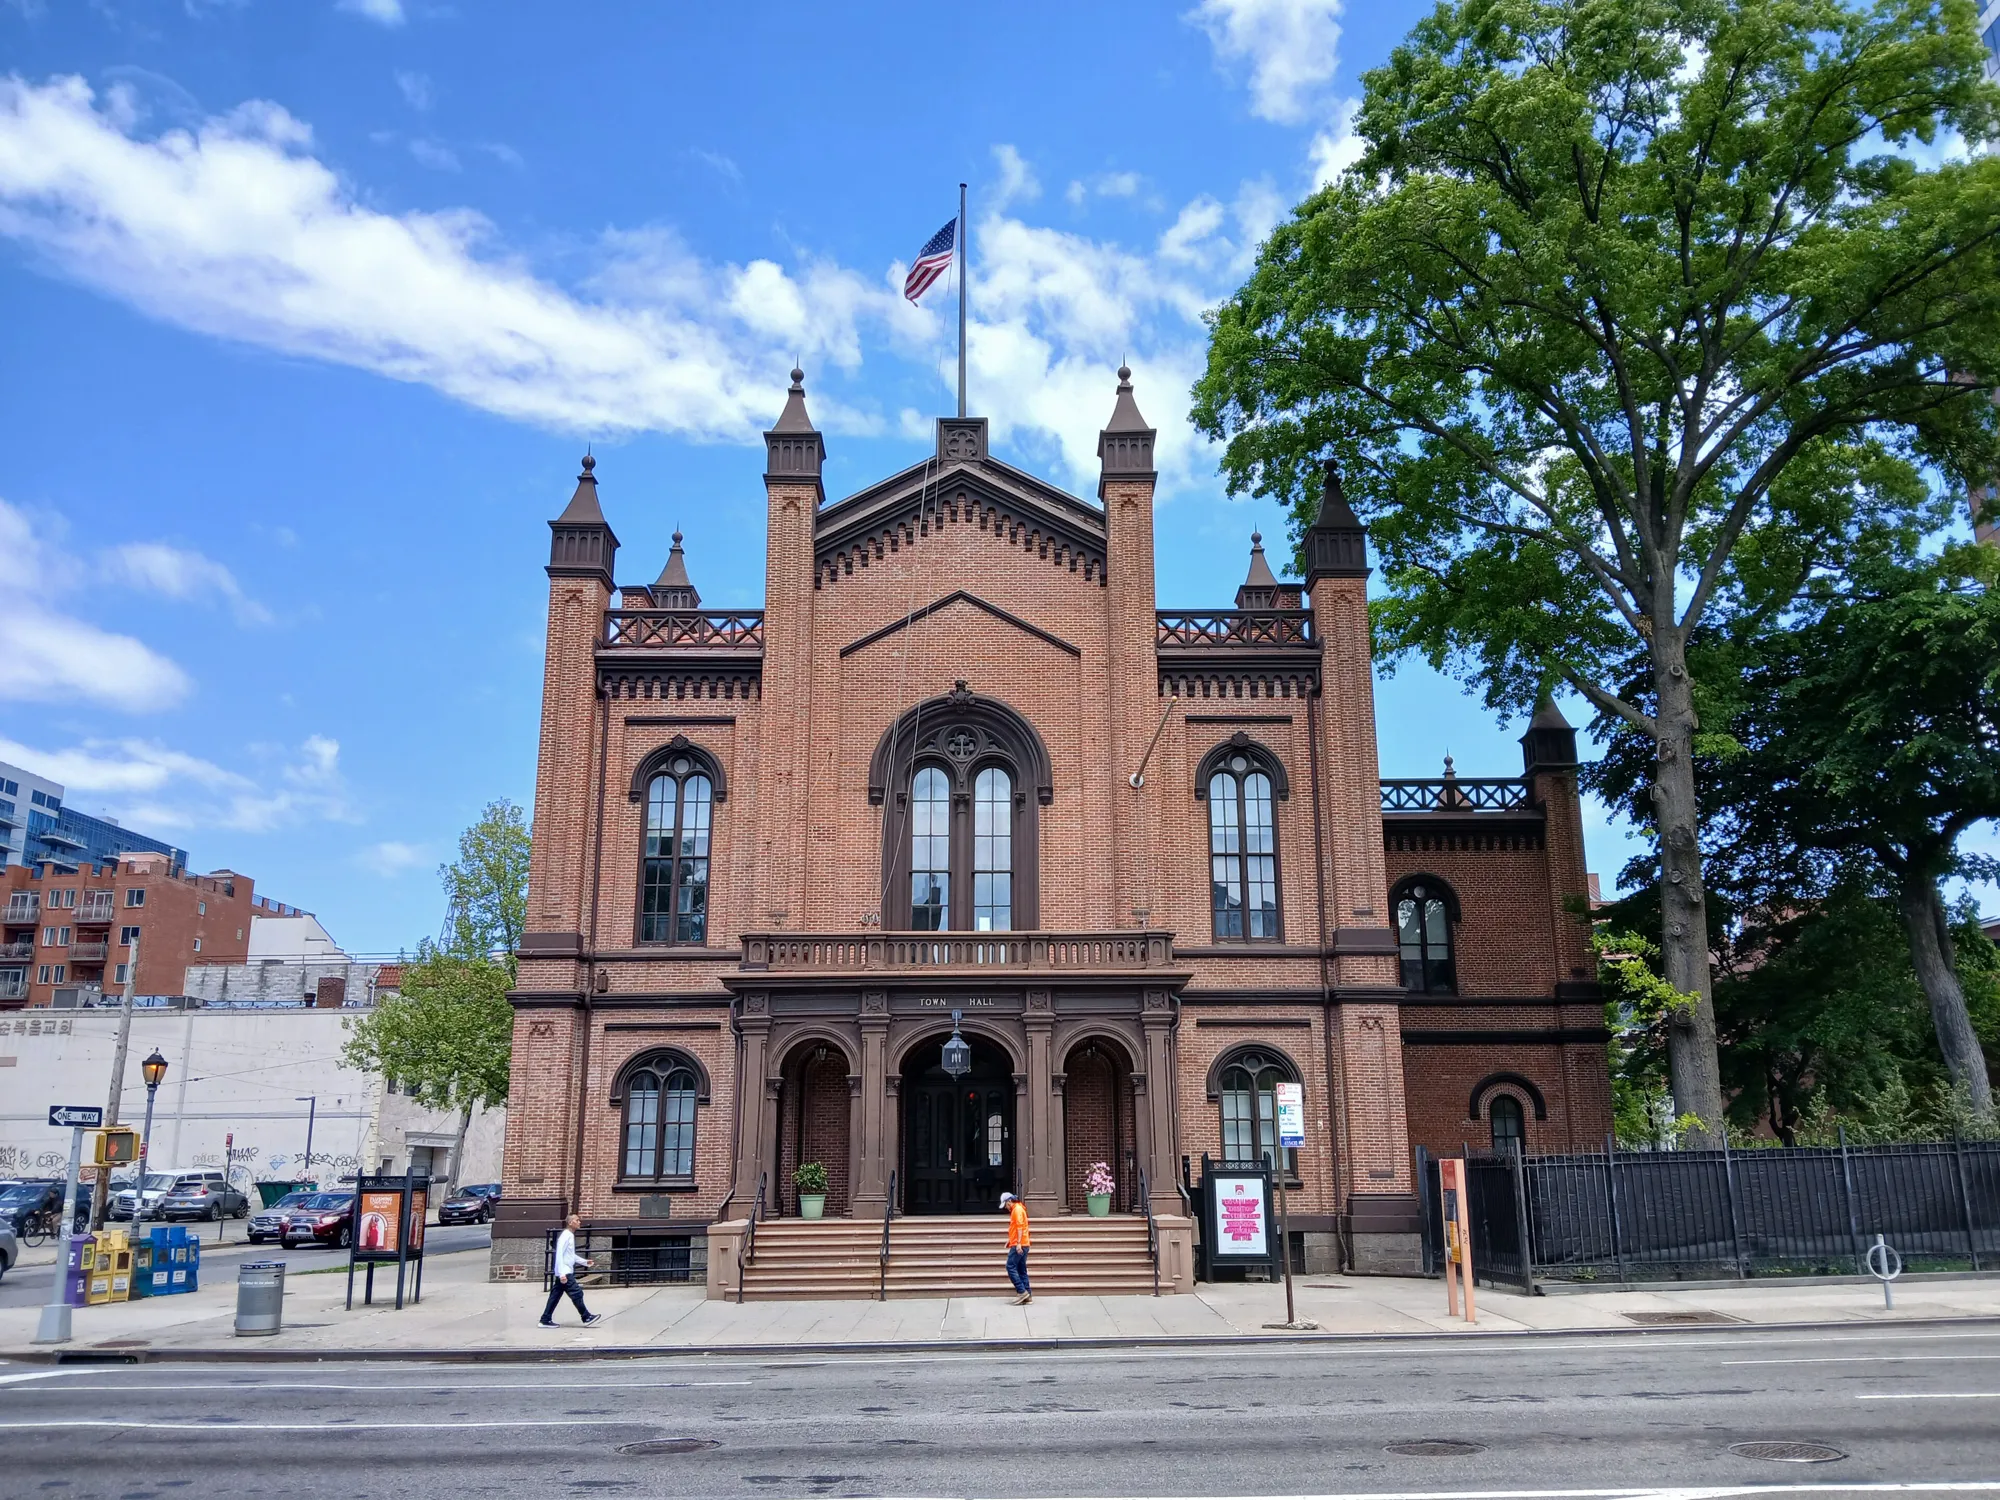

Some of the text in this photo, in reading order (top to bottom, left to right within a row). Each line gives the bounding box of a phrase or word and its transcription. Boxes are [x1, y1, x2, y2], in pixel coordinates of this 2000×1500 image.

[920, 998, 995, 1006] TOWN HALL
[57, 1111, 97, 1122] ONE WAY
